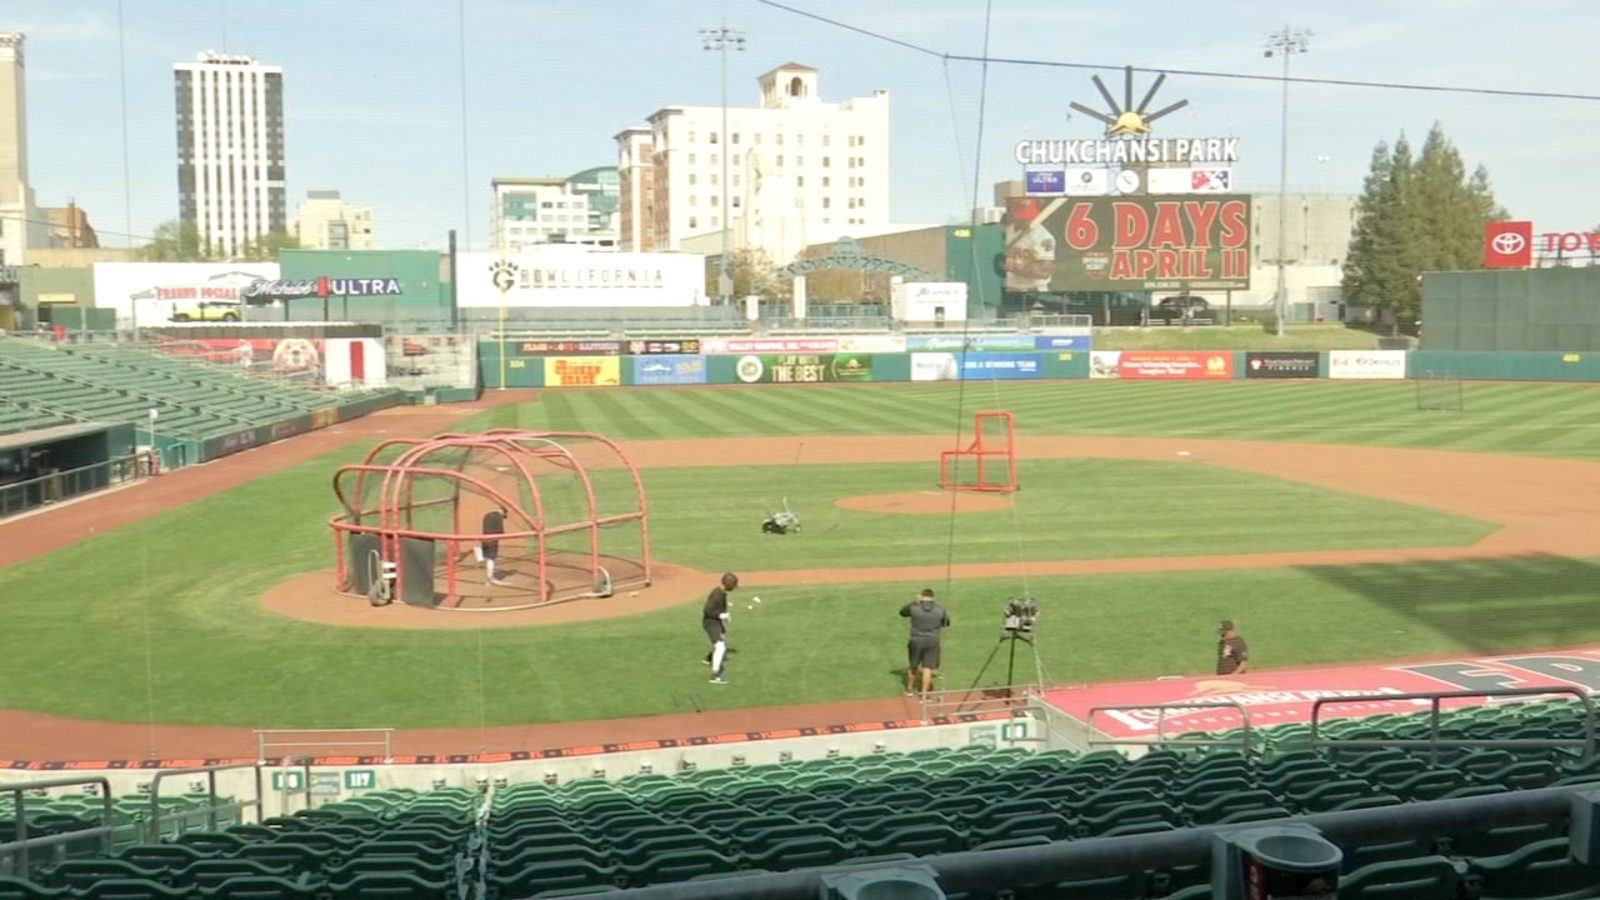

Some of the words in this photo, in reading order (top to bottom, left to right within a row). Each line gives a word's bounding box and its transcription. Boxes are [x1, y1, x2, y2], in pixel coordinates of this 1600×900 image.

[1015, 139, 1168, 163] CHUKCHANSI
[1176, 138, 1238, 162] PARK
[1065, 201, 1099, 250] 6
[1111, 200, 1248, 249] DAYS
[1109, 249, 1213, 280] APRIL
[331, 278, 401, 296] ULTRA
[771, 365, 794, 382] THE
[794, 364, 826, 382] BEST
[349, 772, 371, 787] 117
